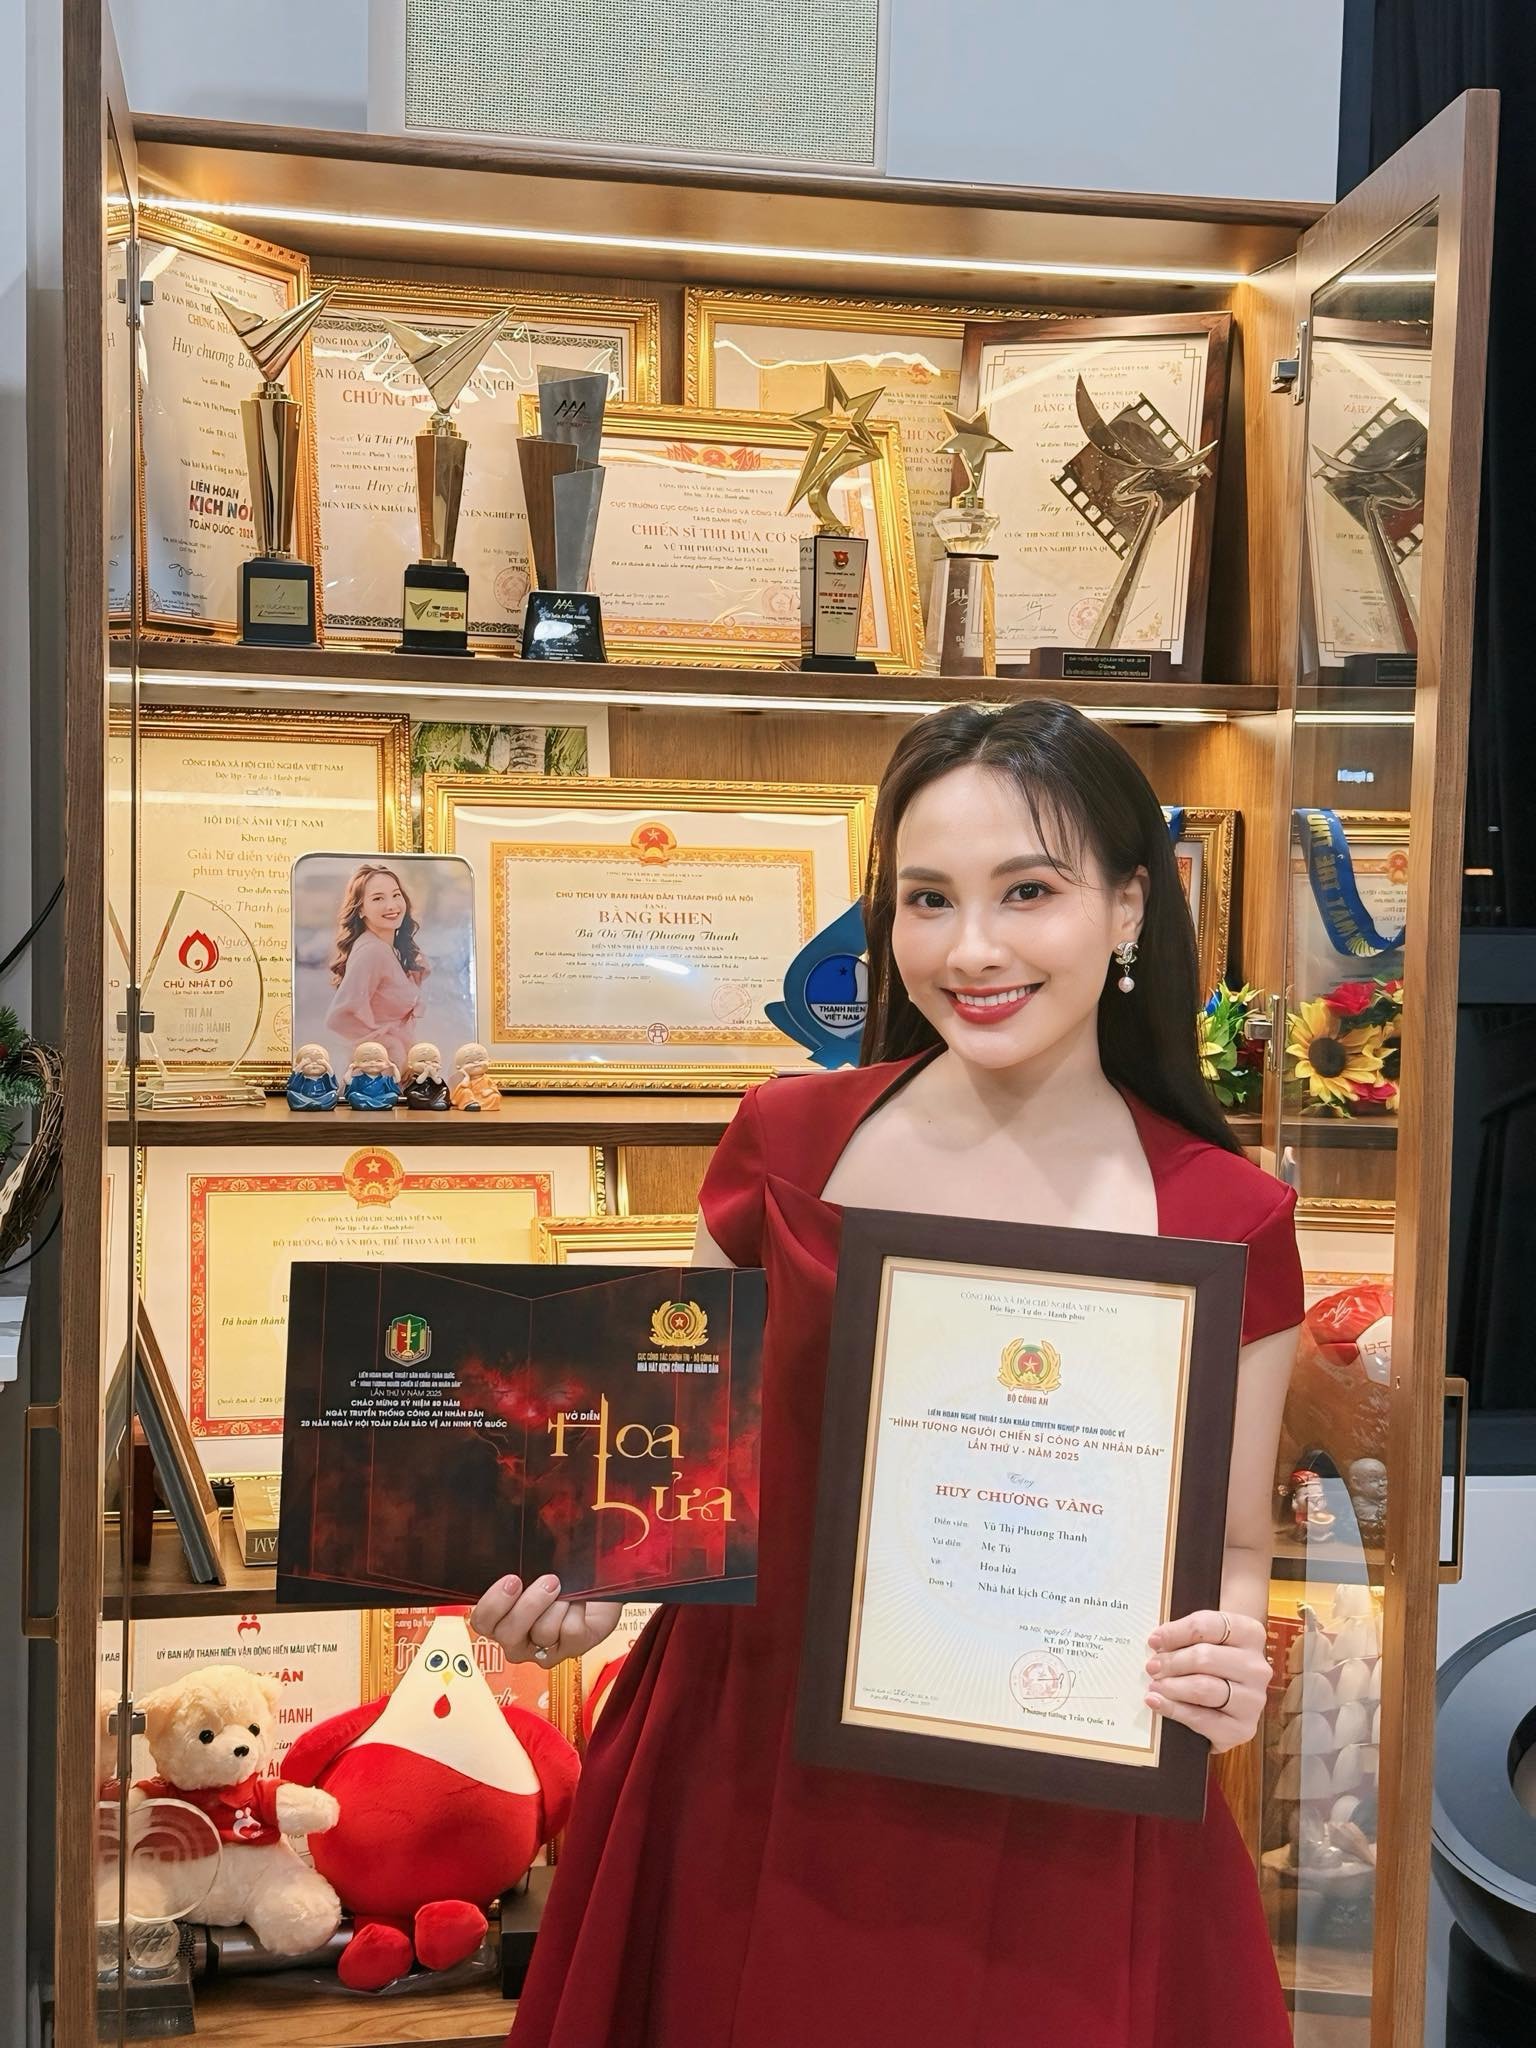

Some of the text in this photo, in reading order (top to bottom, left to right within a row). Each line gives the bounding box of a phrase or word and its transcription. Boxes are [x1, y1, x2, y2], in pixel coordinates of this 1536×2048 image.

[172, 336, 194, 357] Huy
[196, 343, 235, 367] chương
[342, 388, 406, 407] CHỨNG
[190, 480, 239, 500] LIÊN HOAN
[366, 479, 393, 495] Huy
[190, 494, 223, 517] KỊCH
[189, 518, 211, 530] TOÀN
[212, 521, 235, 536] QUỐC
[631, 521, 678, 537] CHIẾN
[658, 912, 713, 925] KHEN
[163, 977, 185, 988] CHỦ
[819, 1005, 846, 1013] THANH
[370, 1389, 385, 1397] LẦN
[386, 1389, 400, 1397] THỨ
[407, 1389, 425, 1397] NĂM
[1007, 1394, 1049, 1407] BỘ CÔNG AN
[351, 1397, 374, 1407] CHÀO
[376, 1397, 399, 1407] MỪNG
[412, 1398, 430, 1408] NIỆM
[432, 1399, 442, 1407] 80
[443, 1398, 461, 1407] NĂM
[325, 1407, 484, 1418] NGÀY TRUYỀN THỐNG CÔNG AN NHÂN DÂN
[564, 1409, 600, 1421] VỞ DIỄN
[312, 1419, 330, 1427] NĂM
[331, 1419, 354, 1428] NGÀY
[355, 1419, 369, 1429] HỘI
[370, 1418, 392, 1428] TOÀN
[393, 1418, 409, 1428] DÂN
[411, 1418, 428, 1428] BẢO
[429, 1418, 438, 1429] VỆ
[440, 1420, 451, 1428] AN
[453, 1420, 472, 1428] NINH
[473, 1418, 483, 1428] TỔ
[485, 1418, 507, 1429] QUỐC
[547, 1393, 684, 1459] Hoa
[928, 1408, 1126, 1438] LIÊN HOAN NGHỆ THUẬT SÂN KHẤU CHUYÊN NGHIỆP TOÀN QUỐC VỀ
[921, 1419, 958, 1434] TƯỢNG
[961, 1423, 996, 1437] NGƯỜI
[999, 1427, 1031, 1441] CHIẾN
[1033, 1430, 1044, 1443] SĨ
[1046, 1432, 1080, 1447] CÔNG
[1084, 1438, 1098, 1449] AN
[1102, 1440, 1133, 1454] NHÂN
[968, 1438, 1080, 1462] LẦN THỨ V NĂM 2025
[935, 1484, 1105, 1515] HUY CHƯƠNG VÀNG
[983, 1521, 996, 1531] Vũ
[999, 1523, 1014, 1534] Thị
[1017, 1526, 1055, 1541] Phương
[1057, 1530, 1088, 1543] Thanh
[979, 1561, 999, 1573] Hoa
[1001, 1562, 1017, 1575] lửa
[978, 1581, 997, 1593] Nhà
[1000, 1584, 1015, 1595] hát
[1018, 1587, 1038, 1599] kịch
[1041, 1590, 1067, 1604] Công
[1069, 1594, 1080, 1604] an
[1083, 1595, 1108, 1607] nhân
[1110, 1598, 1129, 1610] dân
[167, 1650, 182, 1659] BAN
[183, 1648, 195, 1660] HỘI
[196, 1648, 220, 1658] THANH
[220, 1646, 237, 1657] NIÊN
[272, 1643, 289, 1655] HIẾN
[306, 1643, 321, 1656] VIỆT
[322, 1643, 338, 1654] NAM
[276, 1707, 314, 1724] HANH
